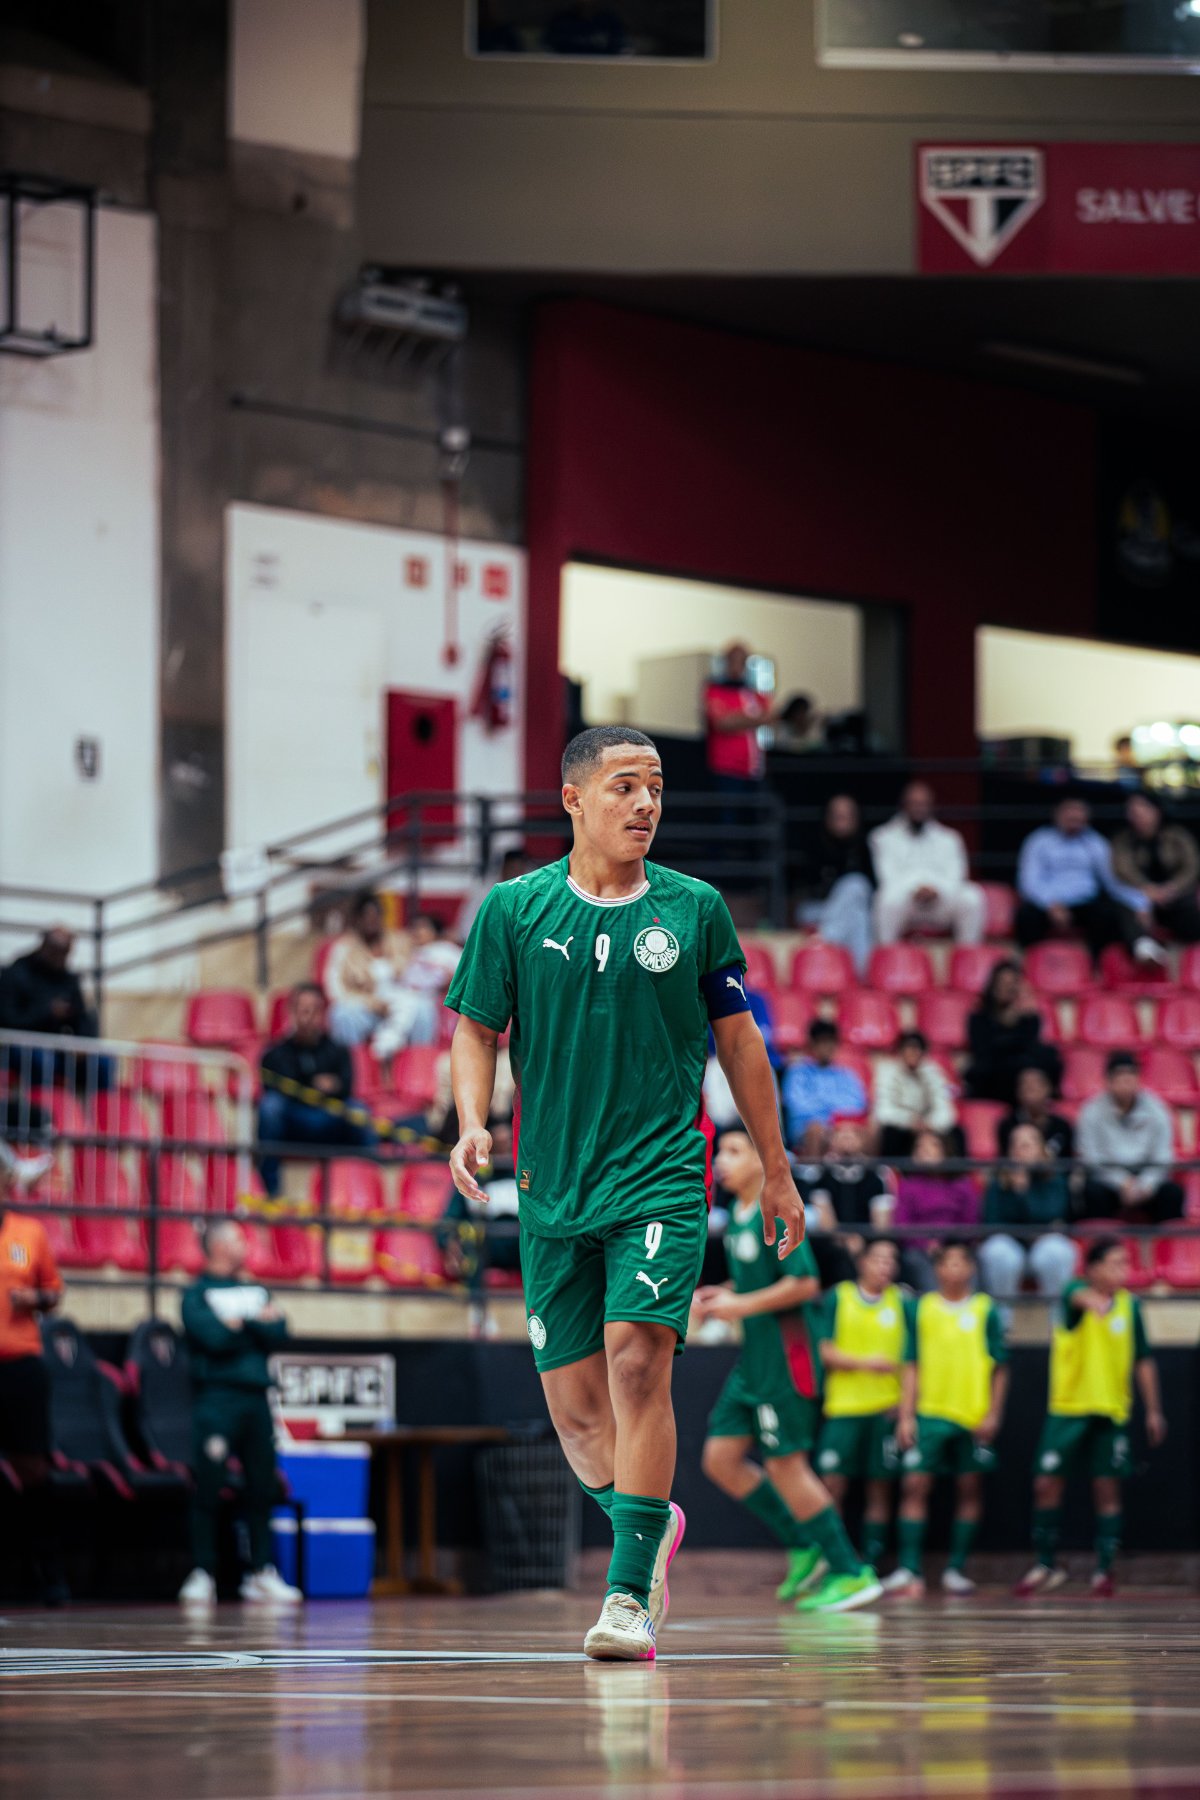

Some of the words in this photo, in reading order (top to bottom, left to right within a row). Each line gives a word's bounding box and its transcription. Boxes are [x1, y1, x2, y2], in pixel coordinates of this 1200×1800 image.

[1076, 188, 1195, 223] SALVE
[595, 933, 610, 972] 9
[637, 946, 676, 970] PALMEIRAS
[645, 1222, 662, 1259] 9
[282, 1365, 380, 1403] SPFC
